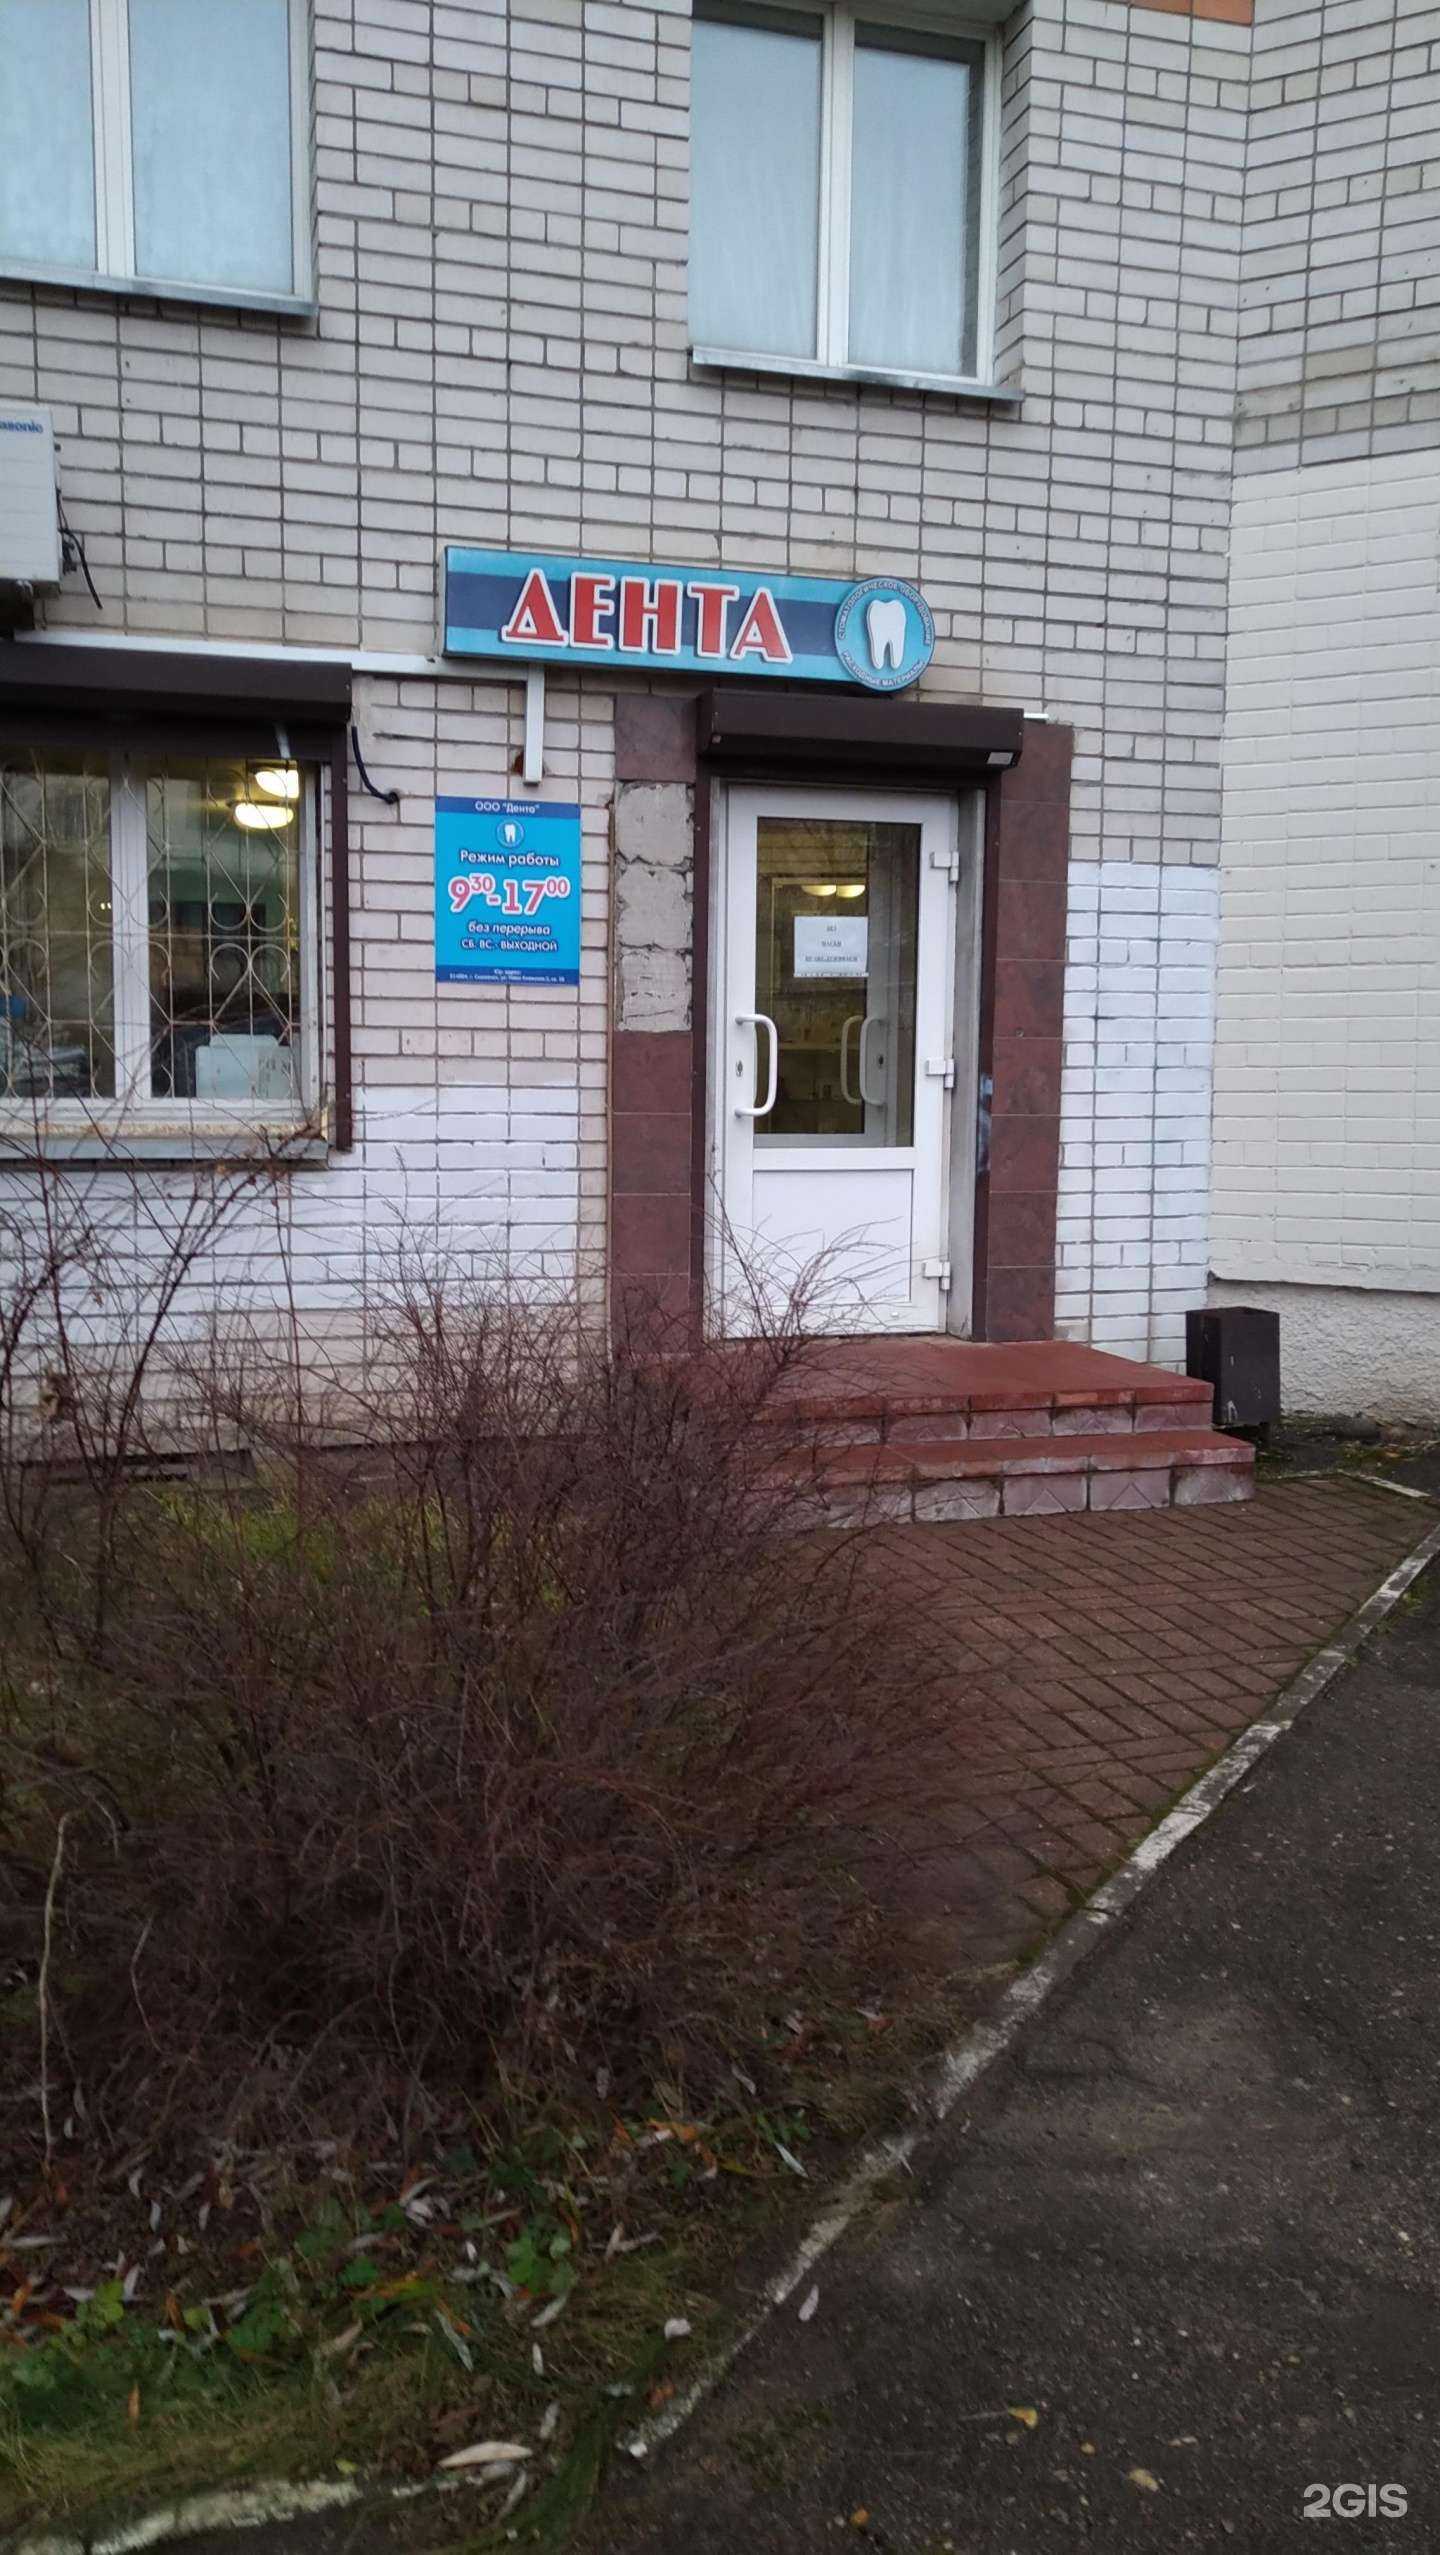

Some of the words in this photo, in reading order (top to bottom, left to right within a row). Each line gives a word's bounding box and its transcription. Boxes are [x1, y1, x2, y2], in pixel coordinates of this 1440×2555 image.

[500, 568, 794, 664] ДЕНТА
[475, 801, 500, 812] ООО
[460, 850, 505, 863] Режим
[508, 853, 559, 867] работы
[468, 921, 489, 932] без
[492, 925, 550, 936] перерыва
[501, 940, 557, 951] ВЫХОДНОЙ
